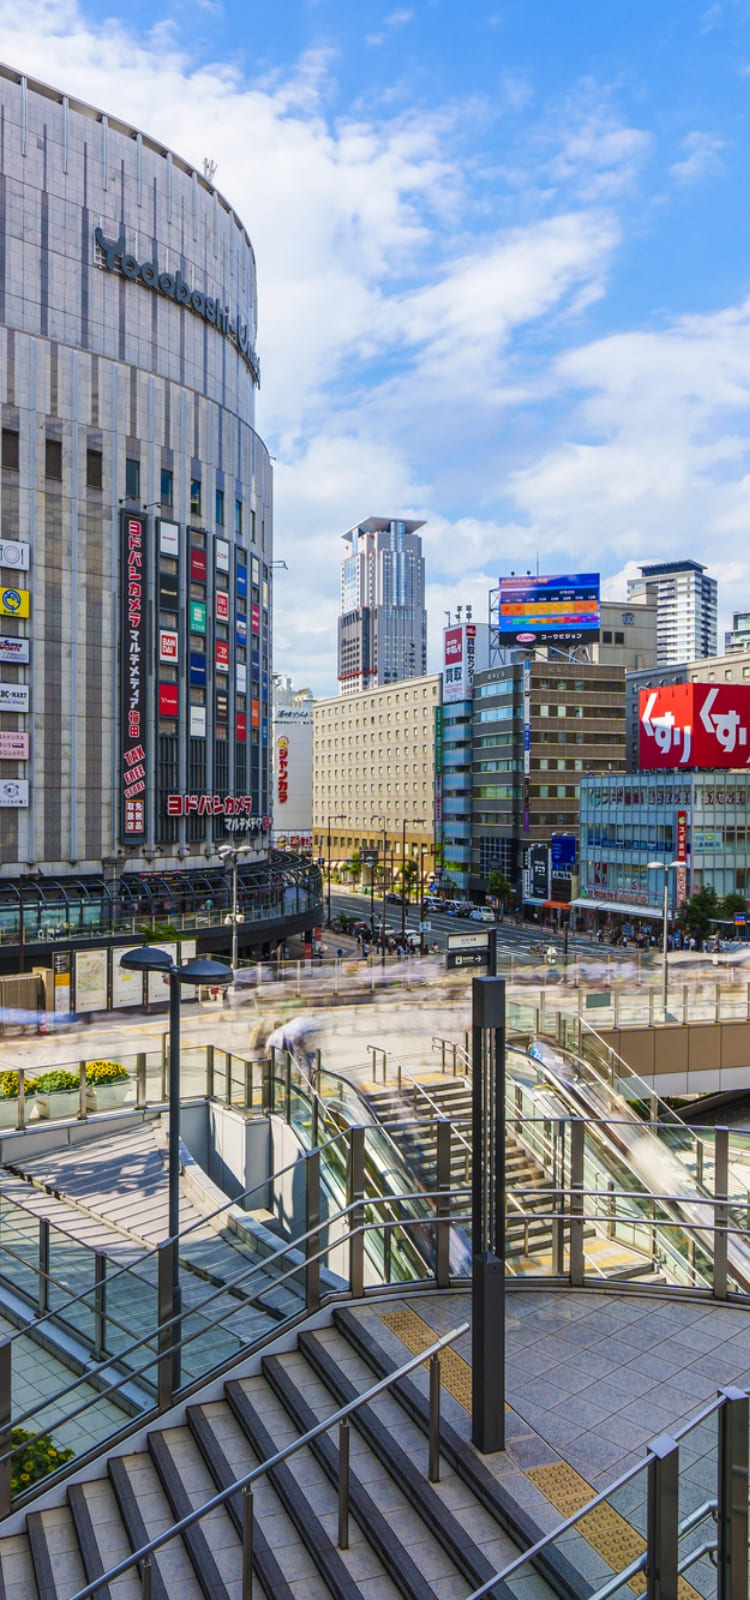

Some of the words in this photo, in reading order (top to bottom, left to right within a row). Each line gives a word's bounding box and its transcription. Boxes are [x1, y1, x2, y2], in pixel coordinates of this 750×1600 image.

[541, 632, 582, 641] コーワビジョン
[0, 689, 28, 699] BC-MART
[642, 692, 691, 763] くすり
[124, 744, 146, 766] TAX
[124, 764, 146, 785] FREE
[278, 748, 289, 804] ジャンカラ
[124, 780, 146, 798] STORE
[168, 795, 252, 815] ヨドバシカメラ
